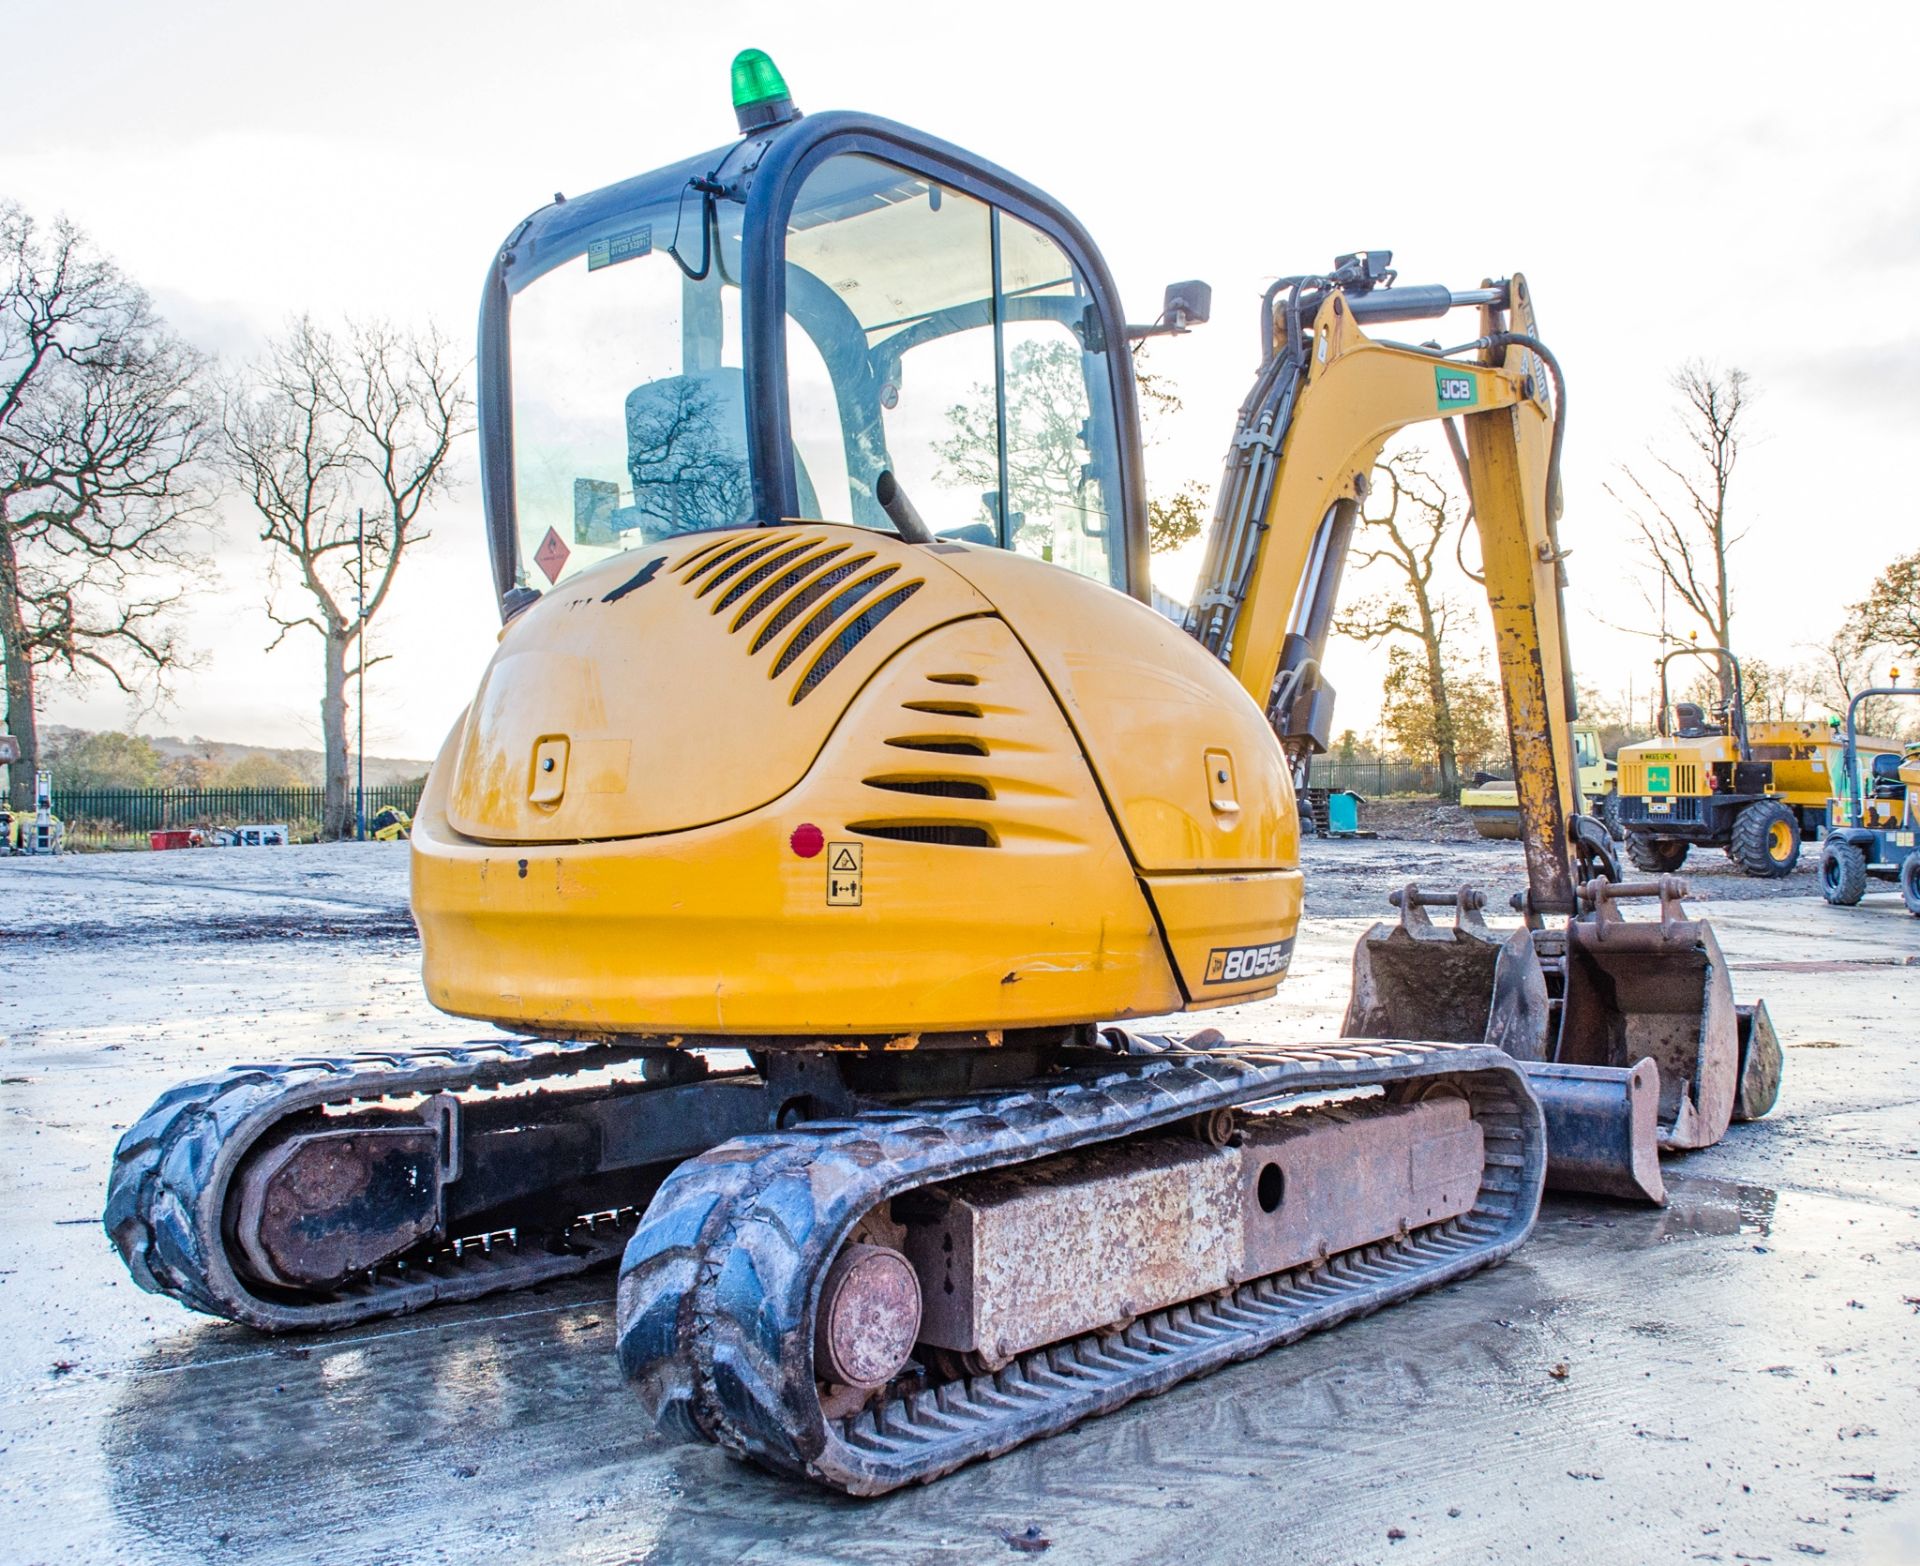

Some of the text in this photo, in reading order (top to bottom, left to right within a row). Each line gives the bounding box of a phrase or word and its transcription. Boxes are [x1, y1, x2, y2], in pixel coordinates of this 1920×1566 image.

[591, 241, 608, 253] JCB
[1441, 379, 1470, 399] JCB
[1223, 944, 1281, 980] 8055
